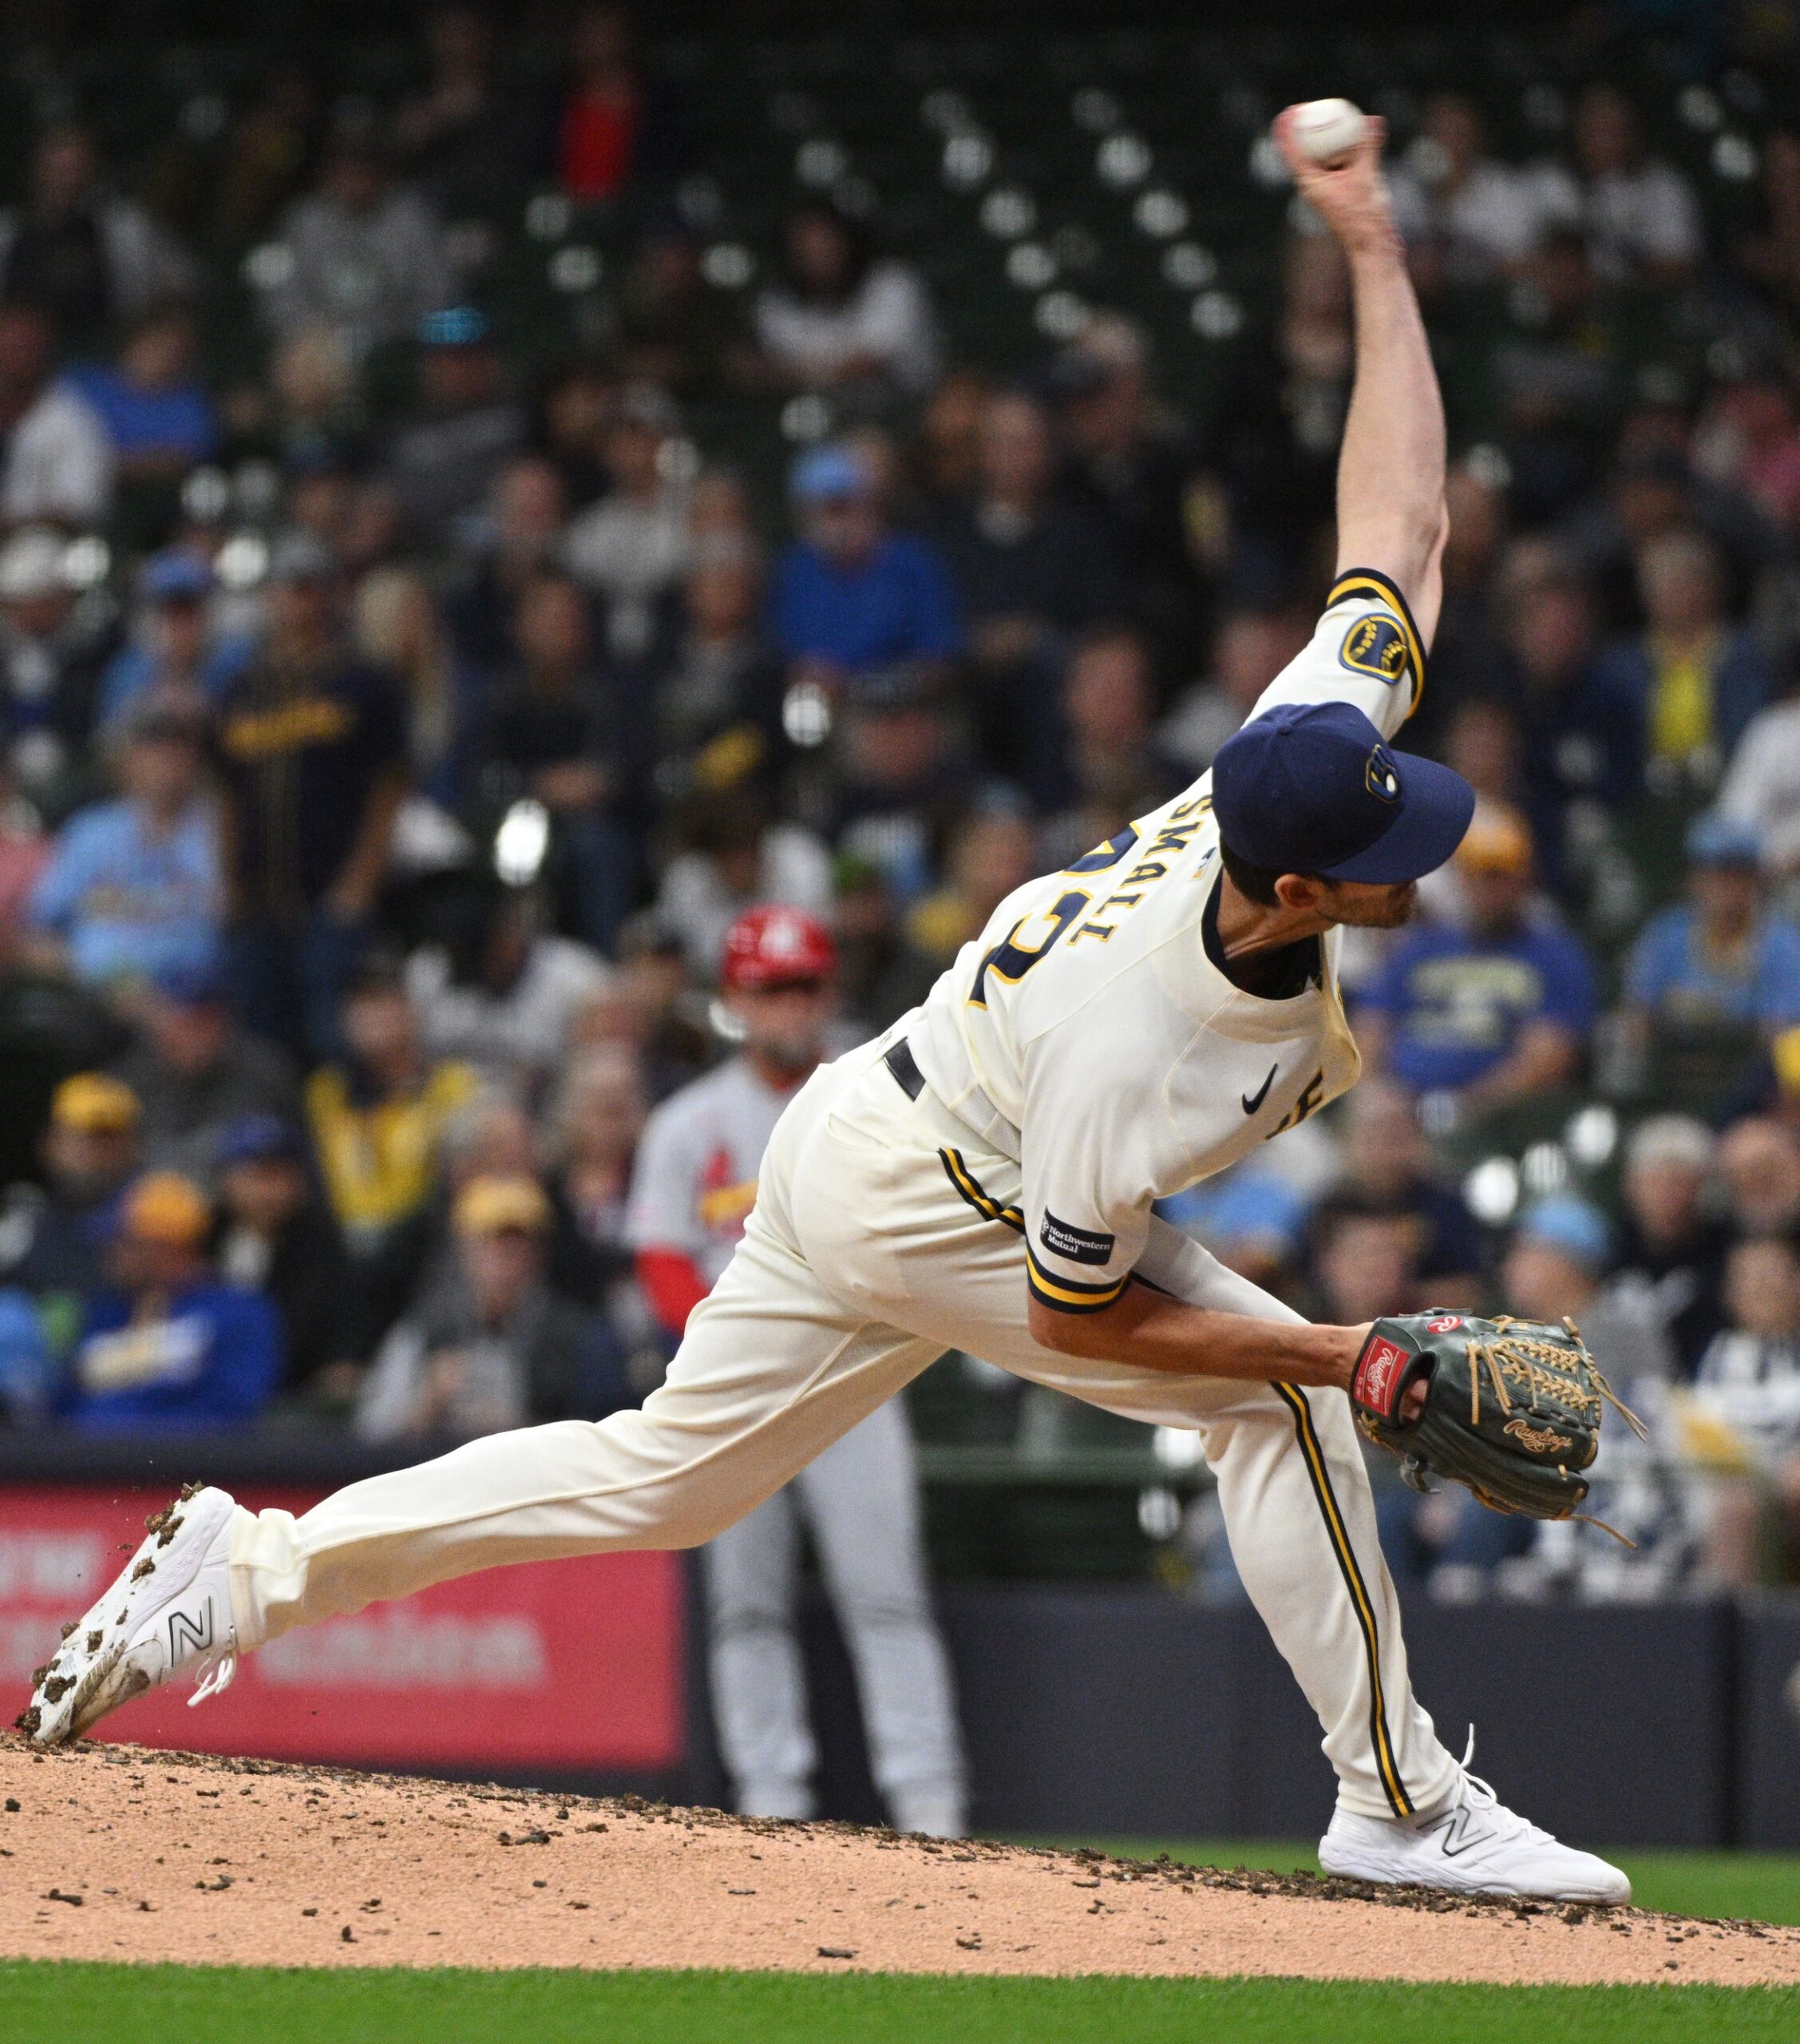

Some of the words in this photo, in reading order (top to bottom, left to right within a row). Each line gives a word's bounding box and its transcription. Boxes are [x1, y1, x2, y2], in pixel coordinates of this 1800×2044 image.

[1066, 794, 1213, 946] SMALL
[1047, 1233, 1079, 1254] Mutual
[1049, 1225, 1110, 1250] Northwestern
[1367, 1347, 1394, 1405] Rawlings
[1503, 1419, 1573, 1453] Rawlings
